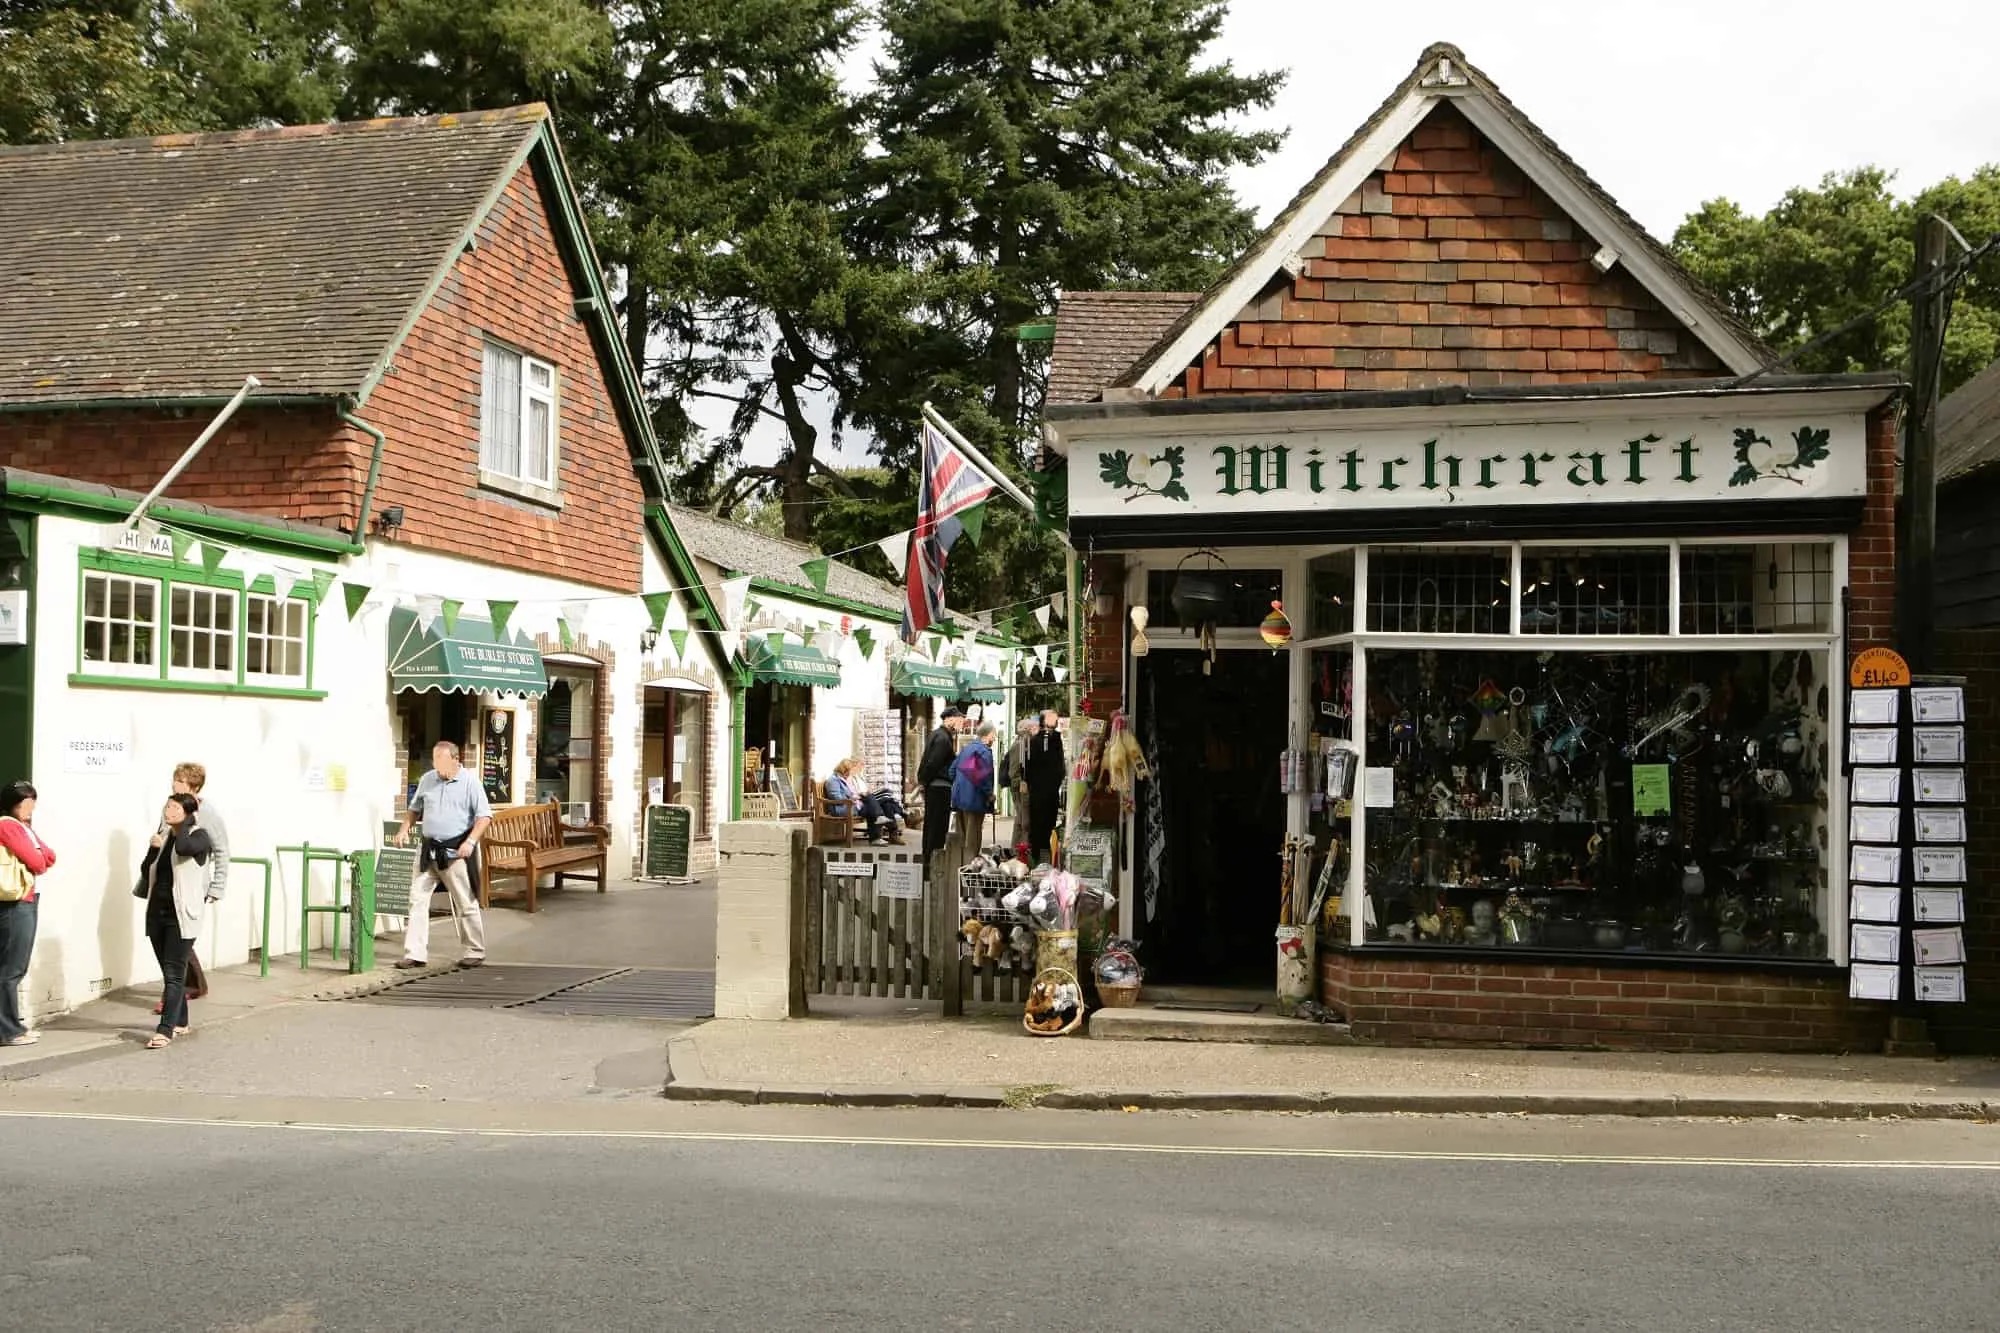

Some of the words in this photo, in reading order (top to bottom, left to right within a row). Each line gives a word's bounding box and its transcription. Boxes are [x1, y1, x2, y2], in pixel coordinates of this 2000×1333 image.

[1211, 432, 1702, 503] Witchcraft
[458, 646, 476, 661] THE
[507, 651, 535, 666] STORES
[1863, 669, 1898, 684] £1.40
[69, 741, 124, 752] PEDESTRIANS
[85, 755, 107, 767] ONLY
